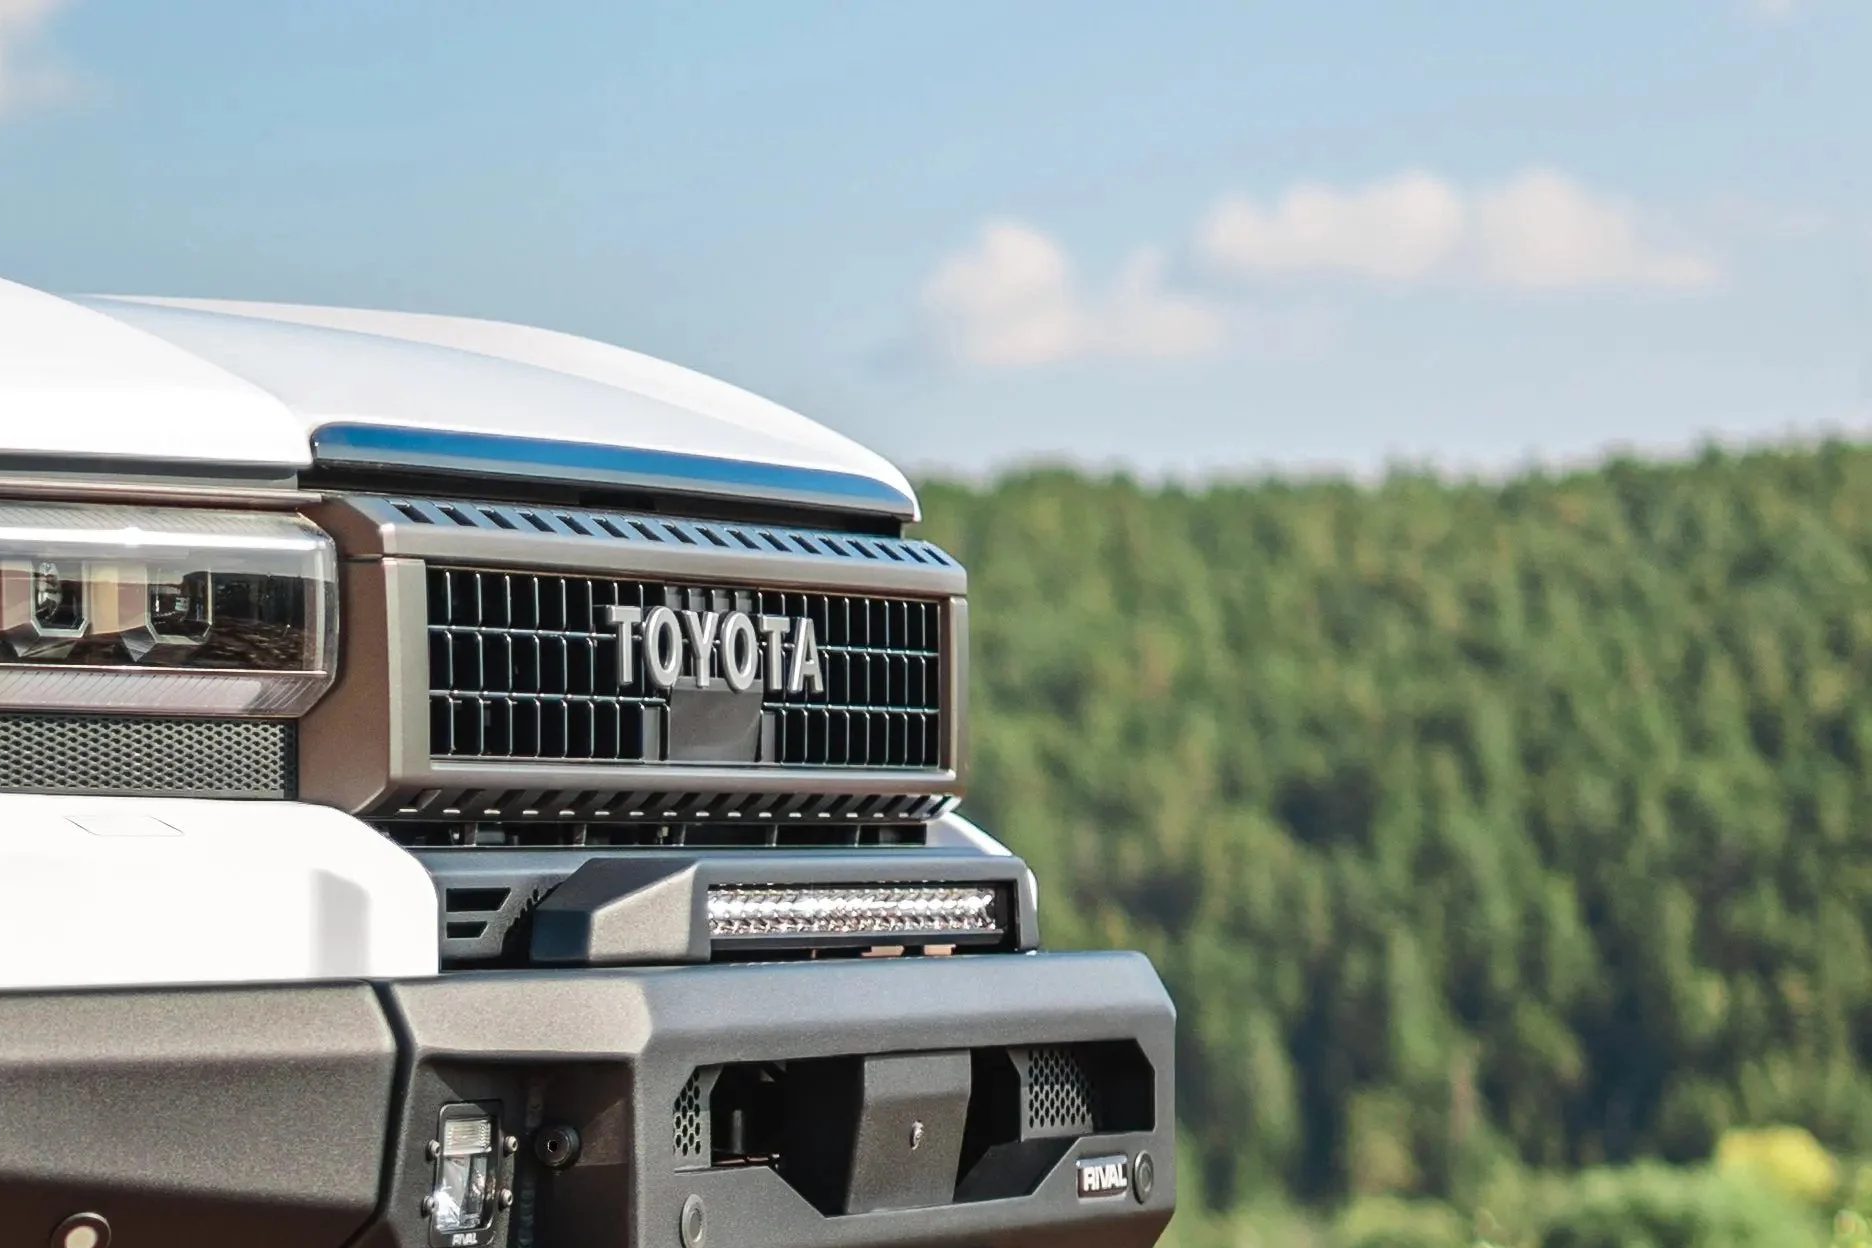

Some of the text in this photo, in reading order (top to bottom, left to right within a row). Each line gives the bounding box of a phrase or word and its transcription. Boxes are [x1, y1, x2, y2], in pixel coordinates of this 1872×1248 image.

[606, 605, 825, 692] TOYOTA
[1083, 1163, 1127, 1192] RIVAL
[452, 1232, 478, 1246] RIVAL
